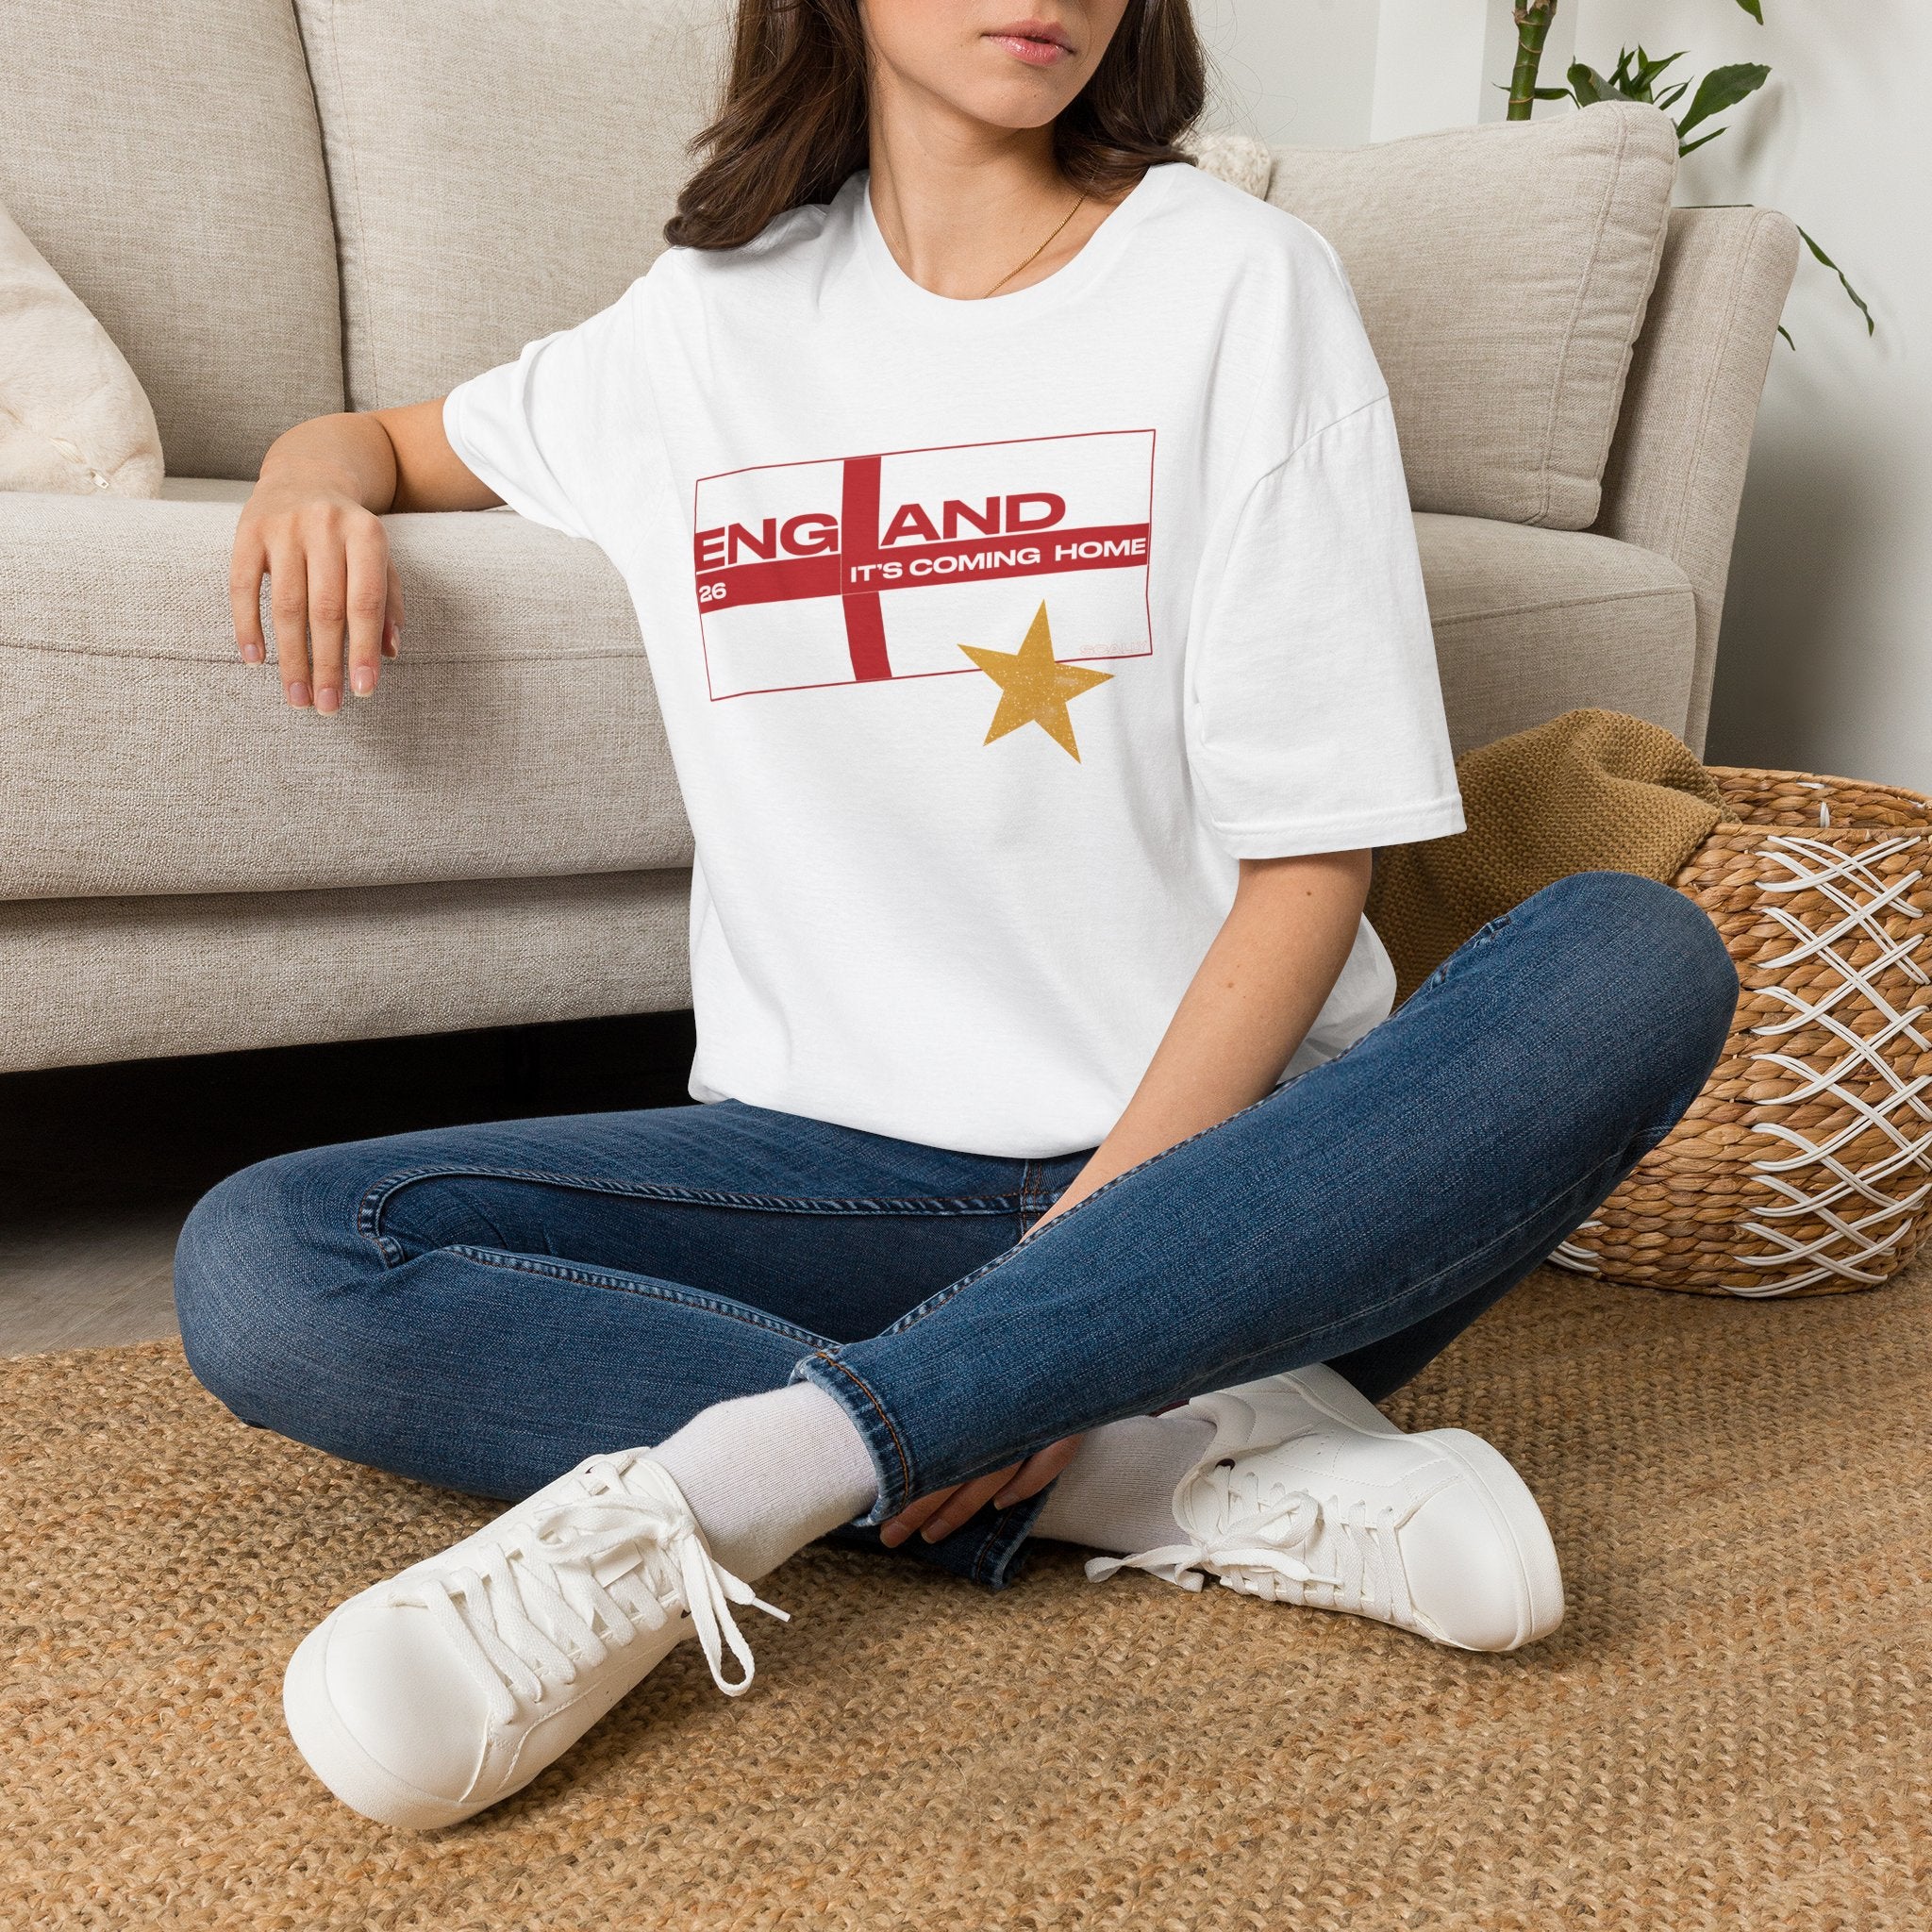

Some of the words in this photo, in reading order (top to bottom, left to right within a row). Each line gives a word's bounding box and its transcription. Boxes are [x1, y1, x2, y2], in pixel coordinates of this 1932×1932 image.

[694, 456, 1066, 573] ENGLAND
[850, 561, 903, 583] IT'S
[908, 547, 1041, 576] COMING
[1055, 537, 1147, 561] HOME
[698, 582, 727, 603] 26
